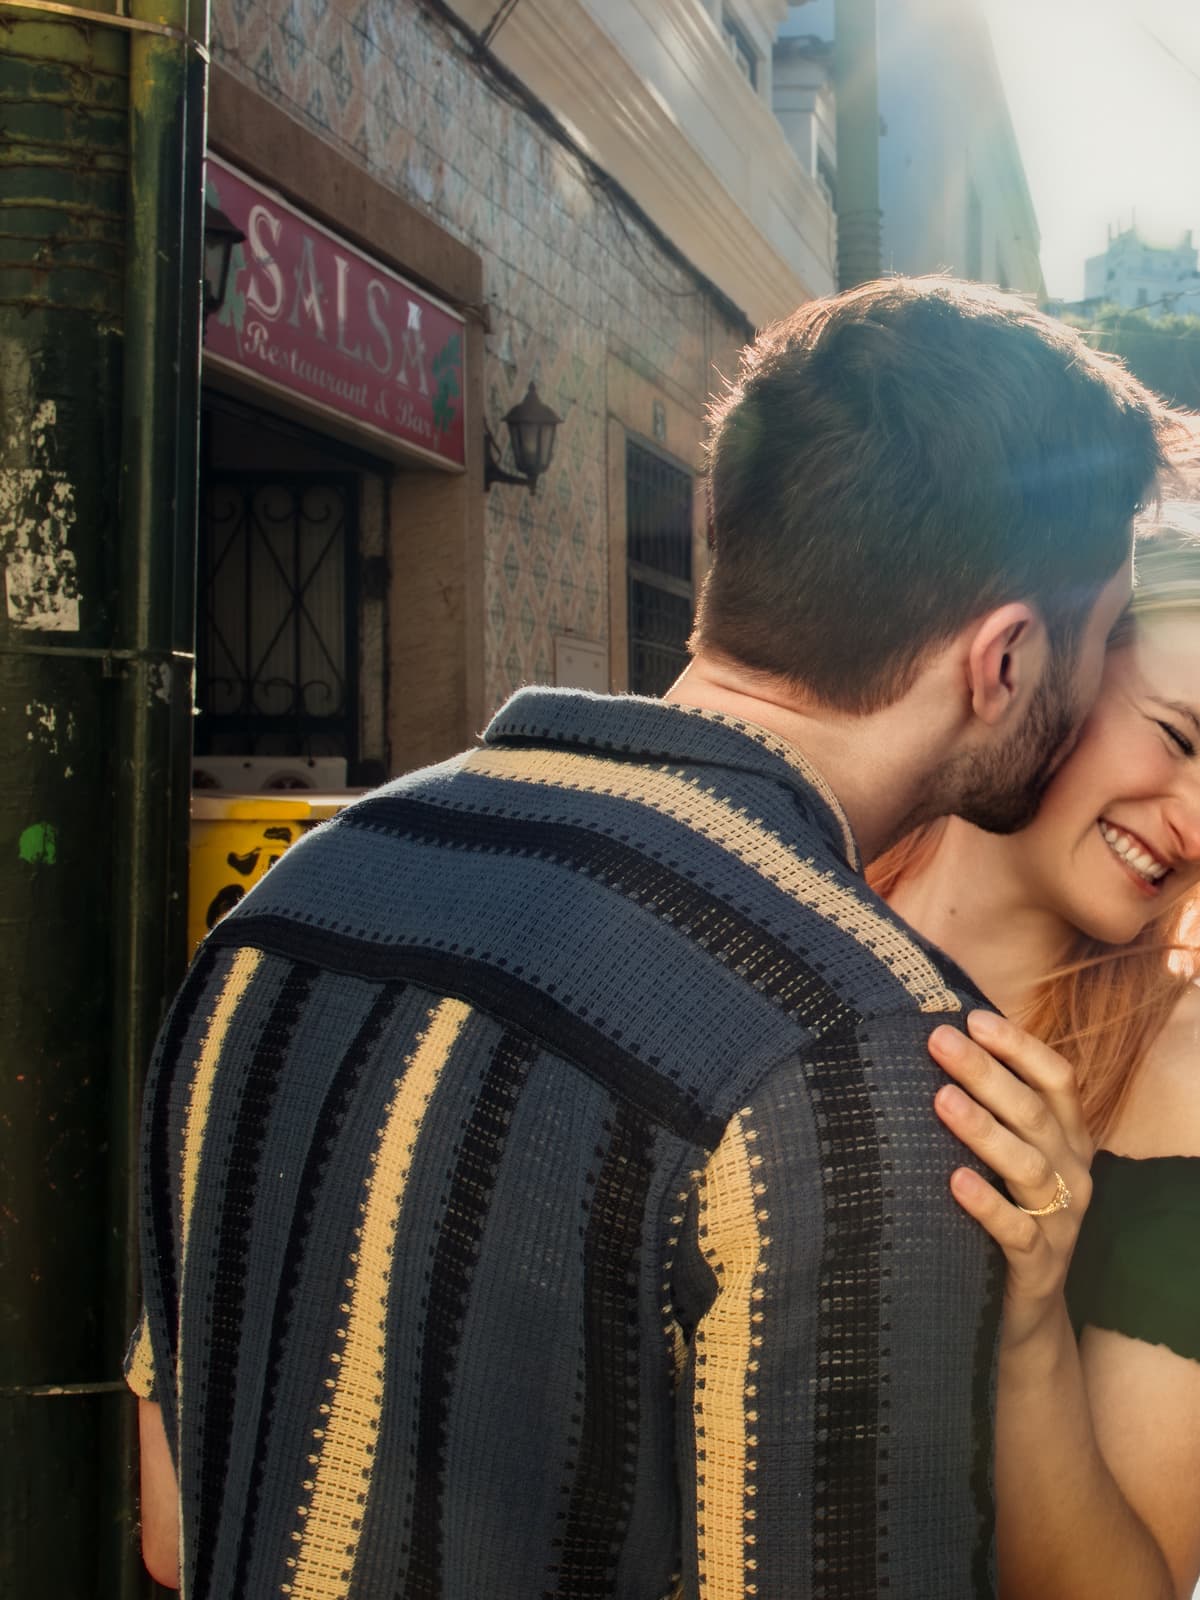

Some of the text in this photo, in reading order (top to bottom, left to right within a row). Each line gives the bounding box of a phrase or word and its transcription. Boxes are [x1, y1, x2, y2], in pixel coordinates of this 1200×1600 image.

[244, 320, 433, 438] Restaurant & Bar
[245, 203, 431, 399] SALSA
